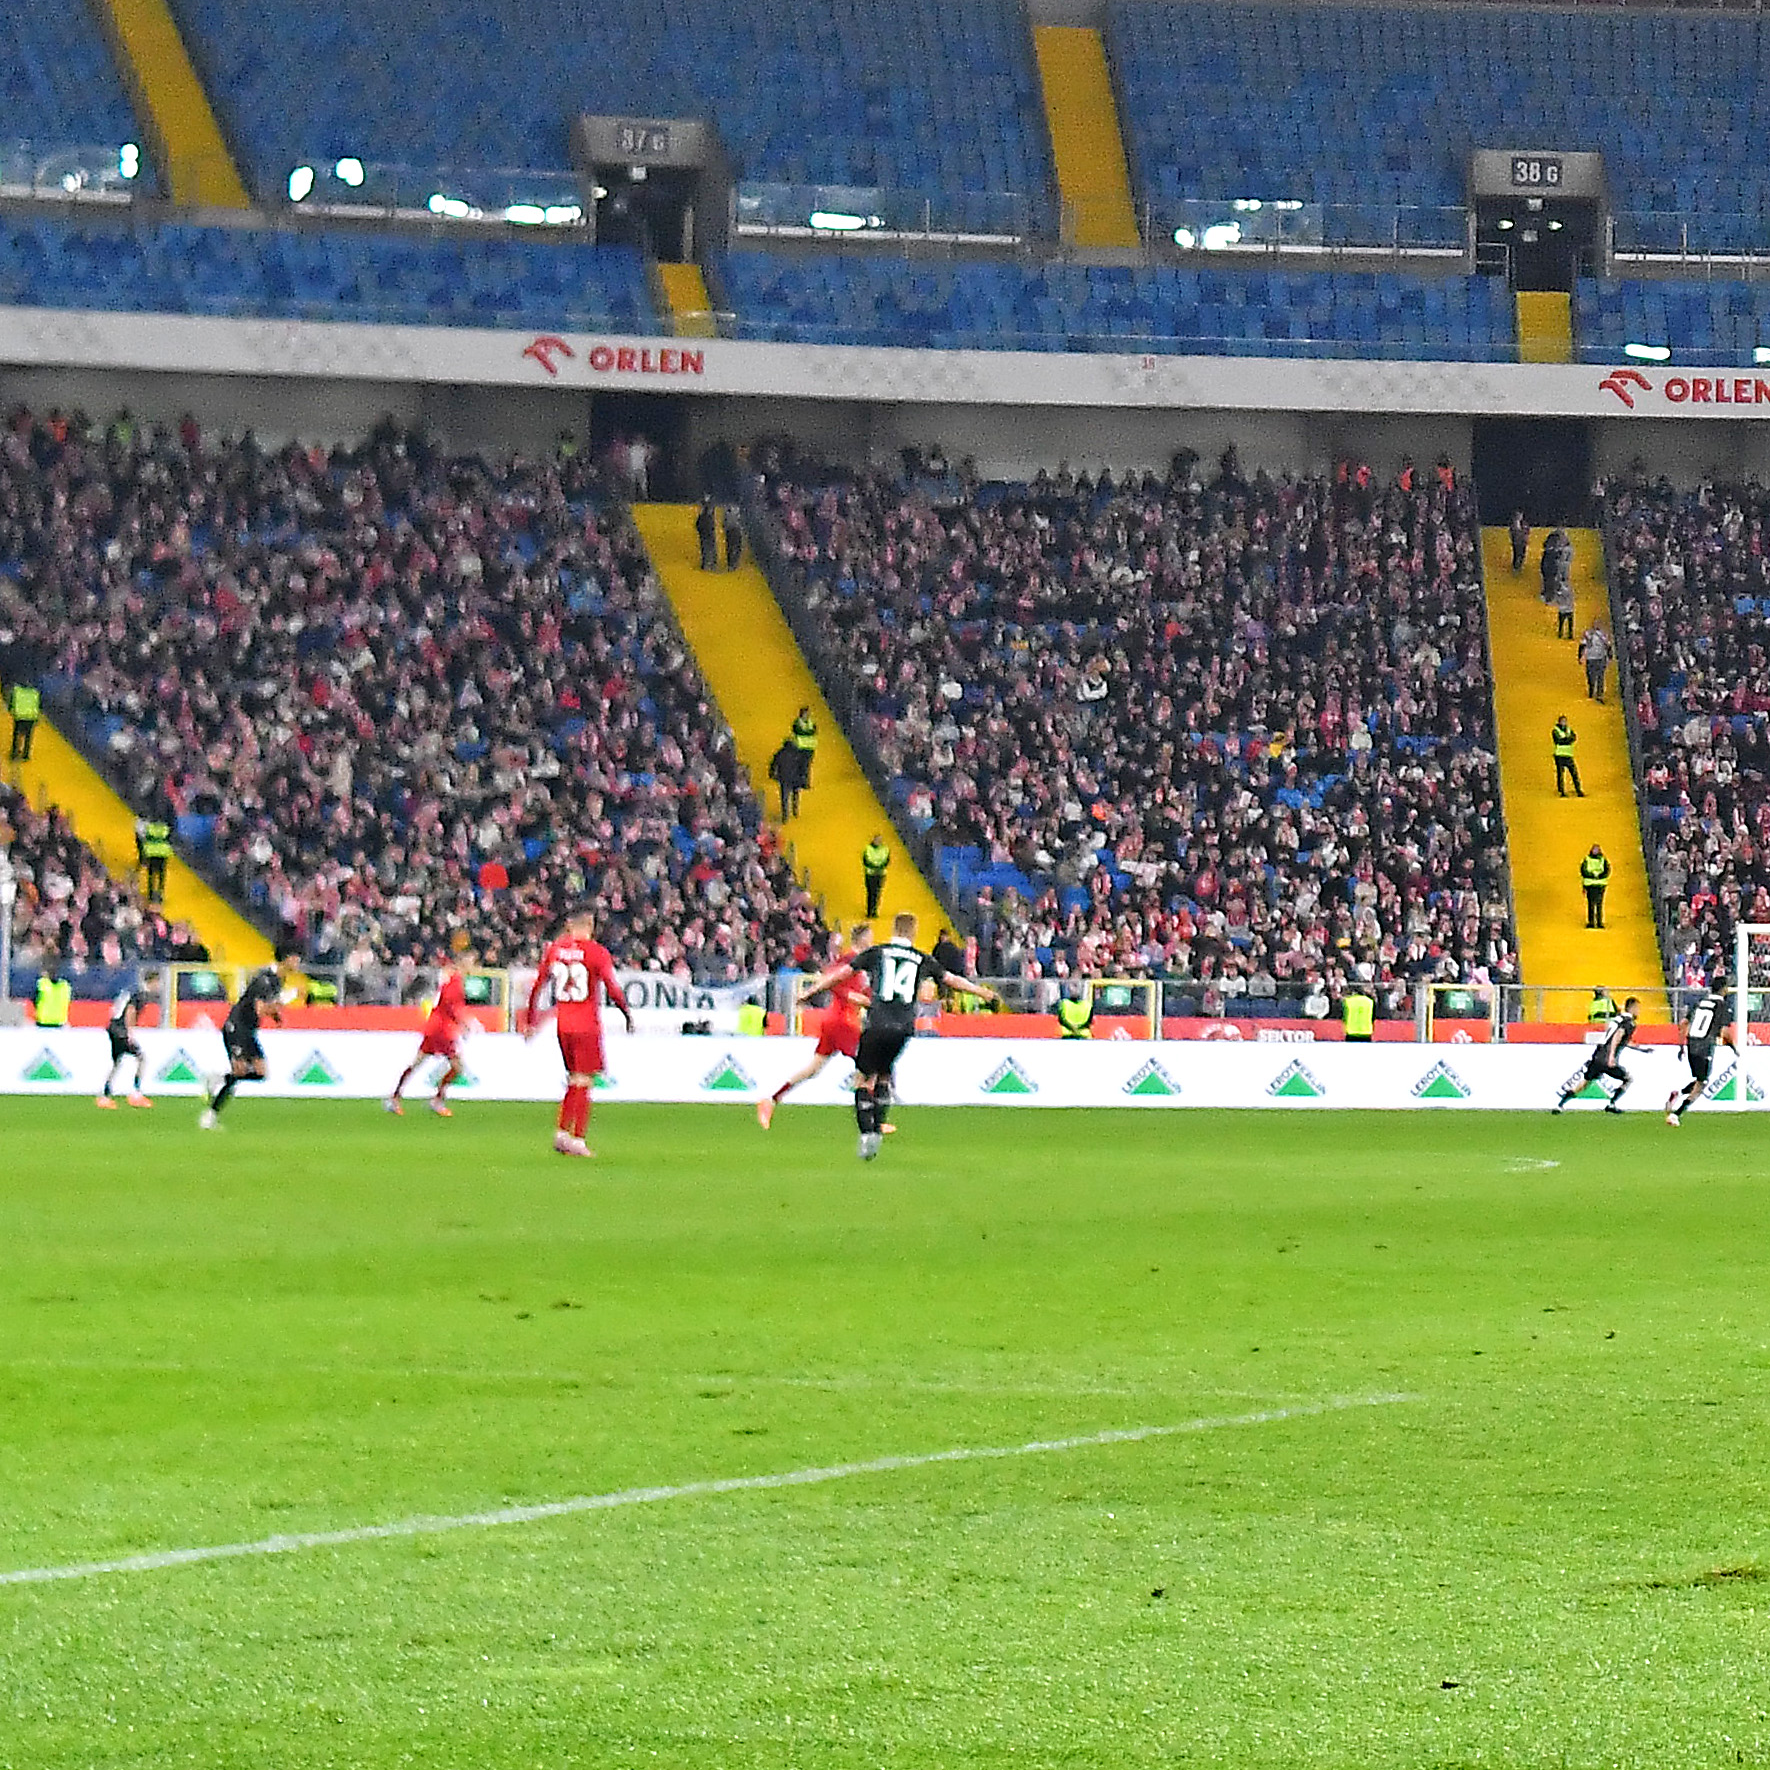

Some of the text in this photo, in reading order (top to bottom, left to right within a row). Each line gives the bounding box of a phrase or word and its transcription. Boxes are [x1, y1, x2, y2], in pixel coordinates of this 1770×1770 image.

[1516, 161, 1558, 183] 38 G
[589, 346, 705, 374] ORLEN
[551, 961, 590, 1003] 23
[881, 957, 919, 1004] 14
[1258, 1029, 1317, 1043] SEKTOR
